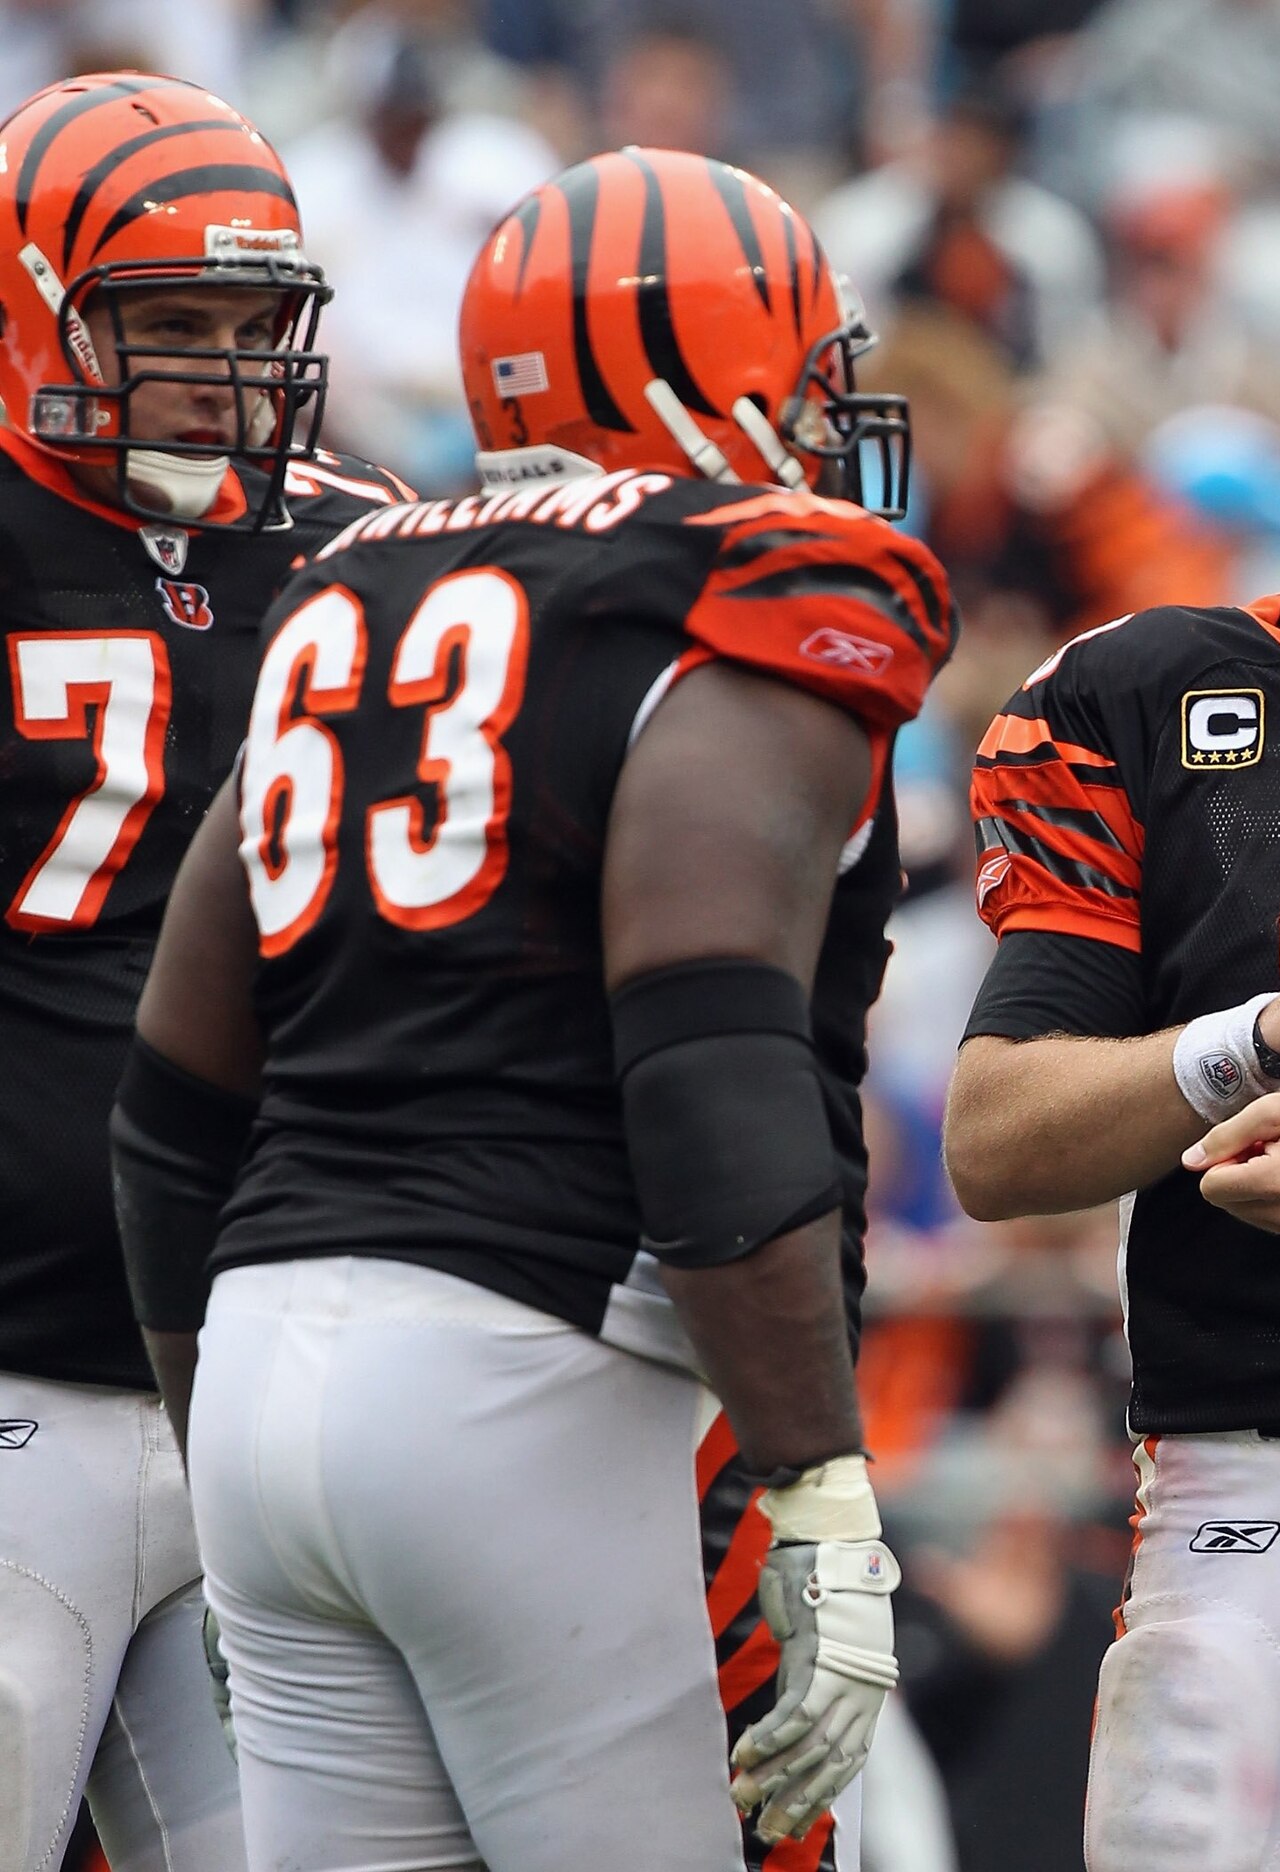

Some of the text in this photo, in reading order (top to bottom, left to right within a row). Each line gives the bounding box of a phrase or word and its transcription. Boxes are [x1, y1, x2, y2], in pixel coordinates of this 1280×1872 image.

[5, 629, 172, 932] 7
[238, 564, 530, 958] 63
[1189, 696, 1258, 751] C
